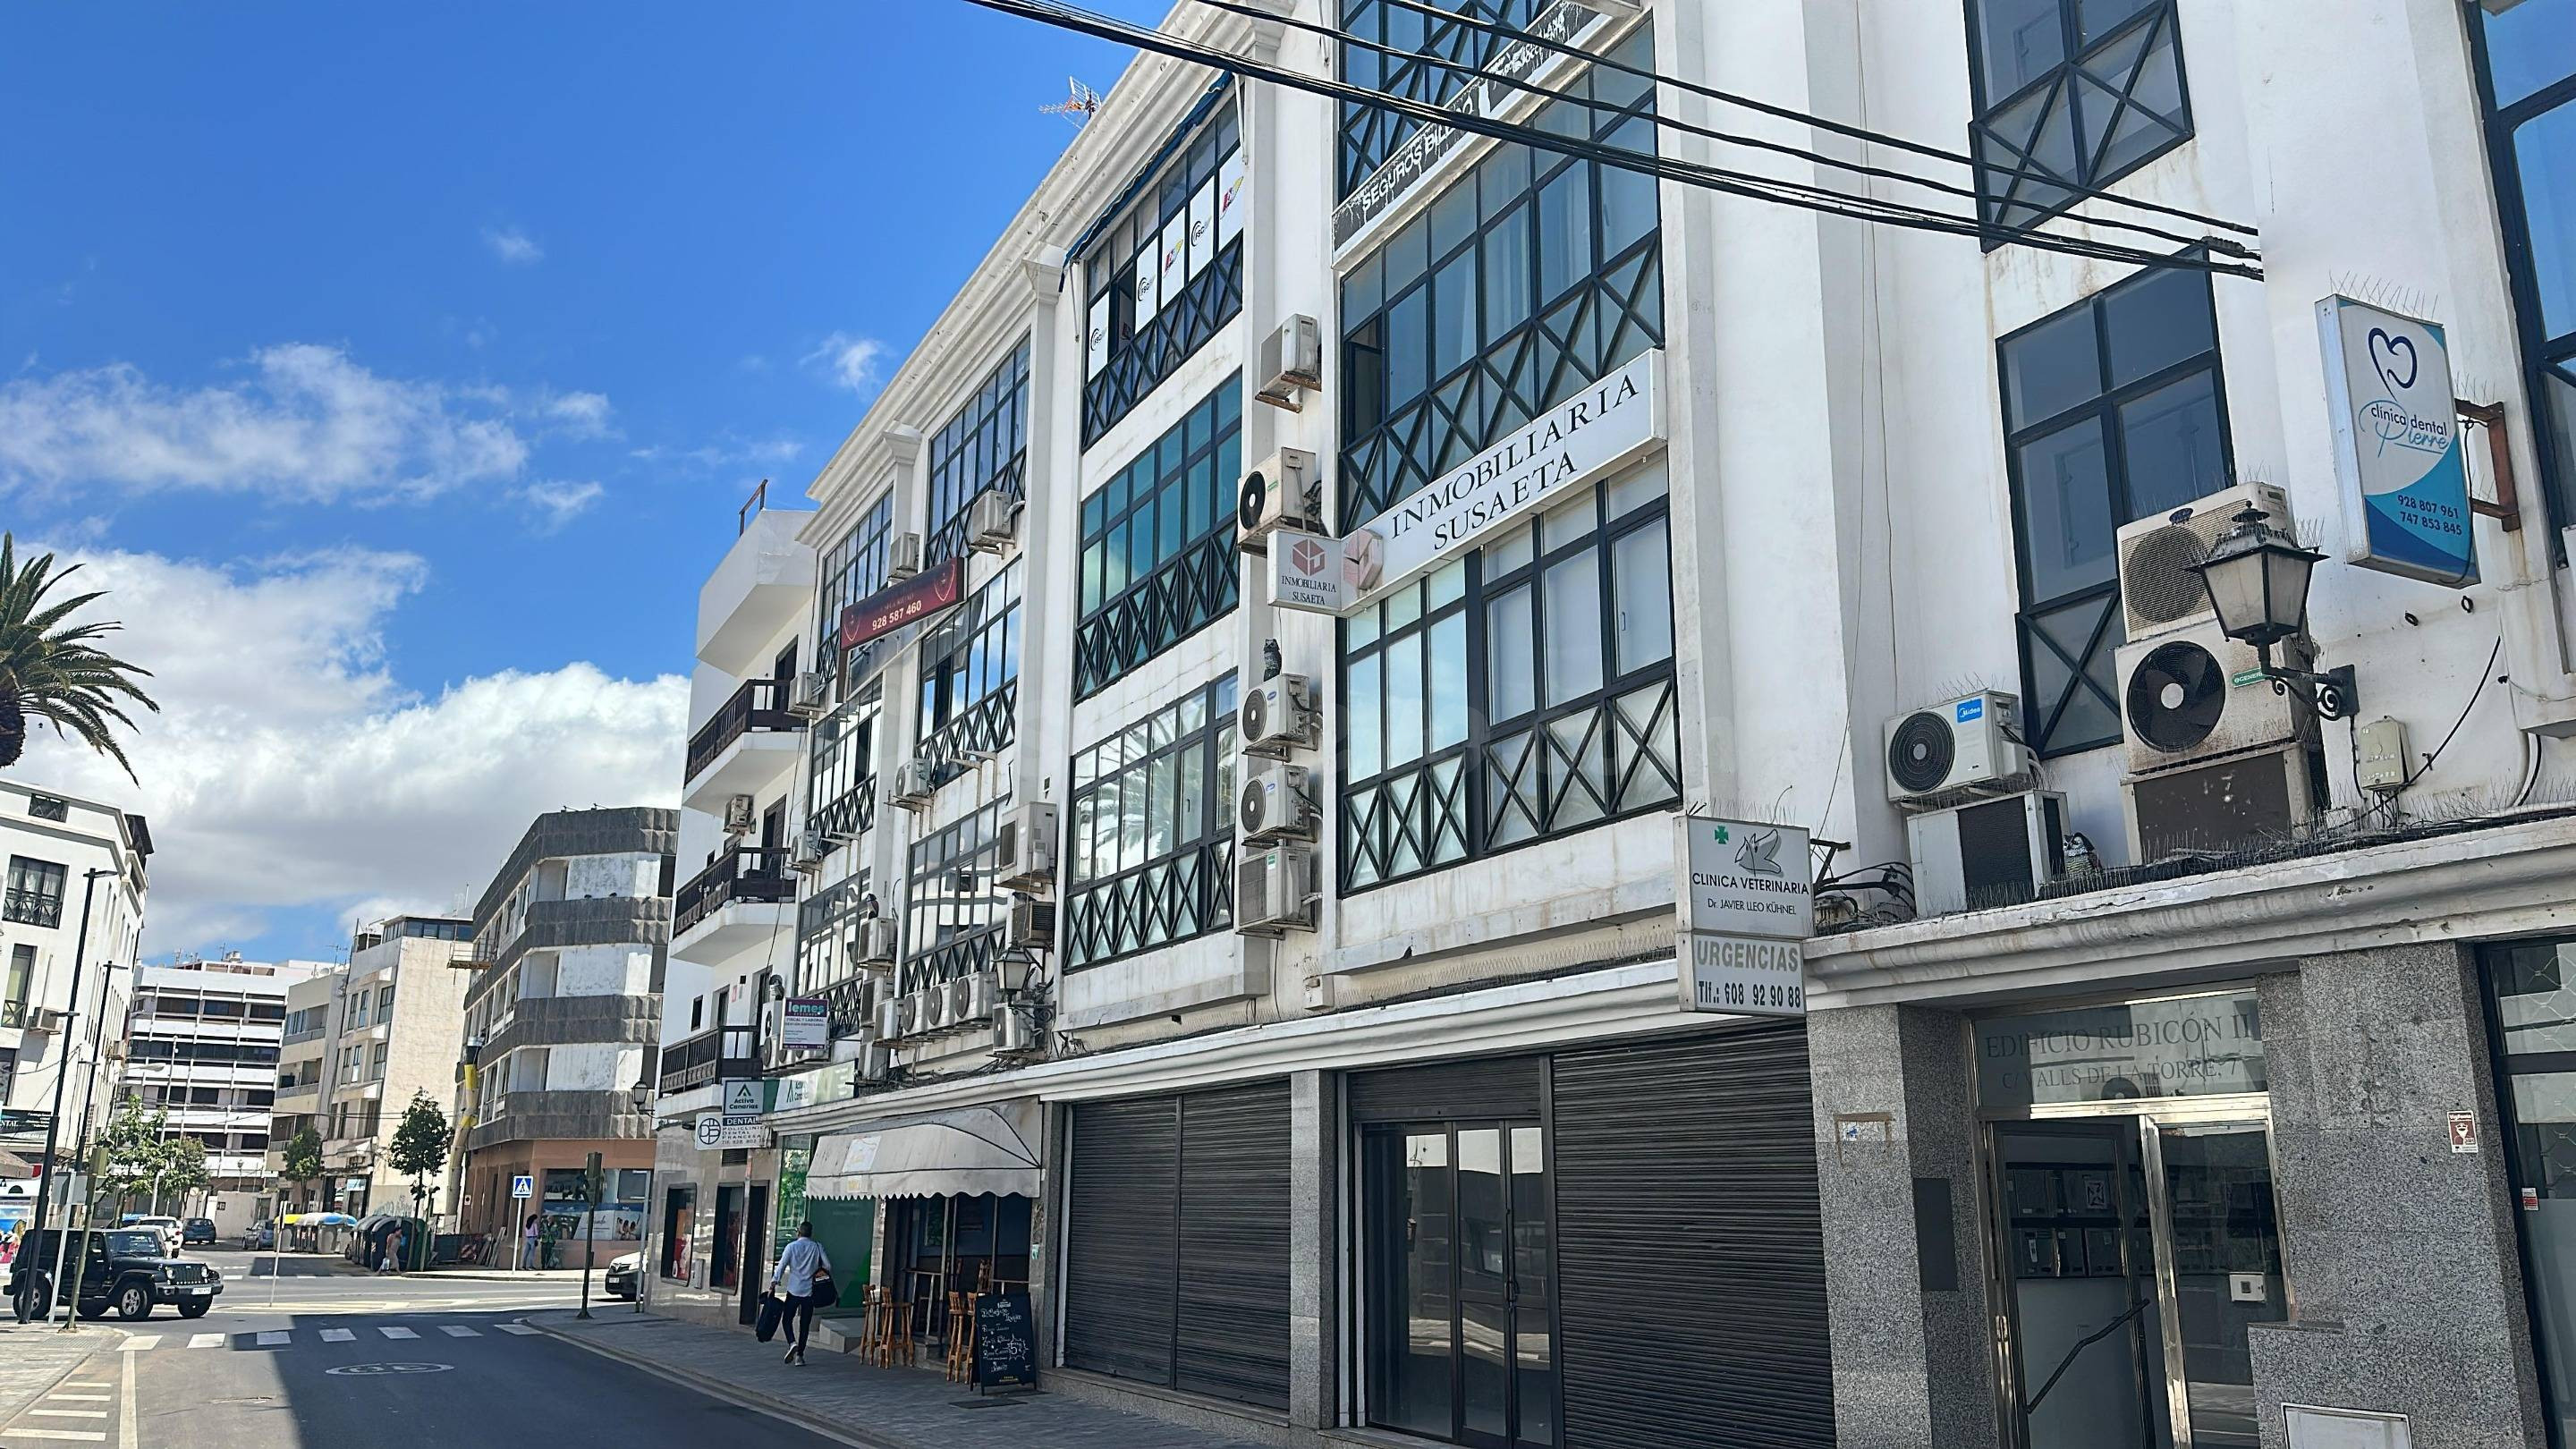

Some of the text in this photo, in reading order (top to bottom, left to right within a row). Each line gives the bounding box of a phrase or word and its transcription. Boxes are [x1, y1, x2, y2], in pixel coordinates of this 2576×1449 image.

[1362, 96, 1473, 211] SEGUROS BILO
[2359, 400, 2449, 458] Pierre
[2371, 403, 2447, 436] clínica dental
[1392, 374, 1640, 539] INMOBILIARIA
[1433, 452, 1578, 550] SUSAETA
[2398, 495, 2459, 519] 928 807 961
[2400, 511, 2462, 535] 747 853 845
[1282, 575, 1336, 592] INMOBILIARIA
[1292, 591, 1326, 605] SUSAETA
[872, 614, 887, 631] 928
[888, 607, 904, 623] 587
[905, 599, 922, 615] 460
[1962, 707, 1981, 716] Midea
[1692, 872, 1809, 895] CLINICA VETERINARIA
[1707, 898, 1796, 915] Dr. JAVIER LLEO KÜHNEL
[1697, 940, 1799, 973] URGENCIAS
[1753, 984, 1766, 1006] 92
[1770, 985, 1784, 1007] 90
[1788, 986, 1801, 1009] 88
[1987, 1029, 2090, 1057] EDIFICIO
[2099, 1012, 2222, 1050] RUBICÓN
[2088, 1065, 2111, 1084] DE
[726, 1117, 758, 1125] DENTAL
